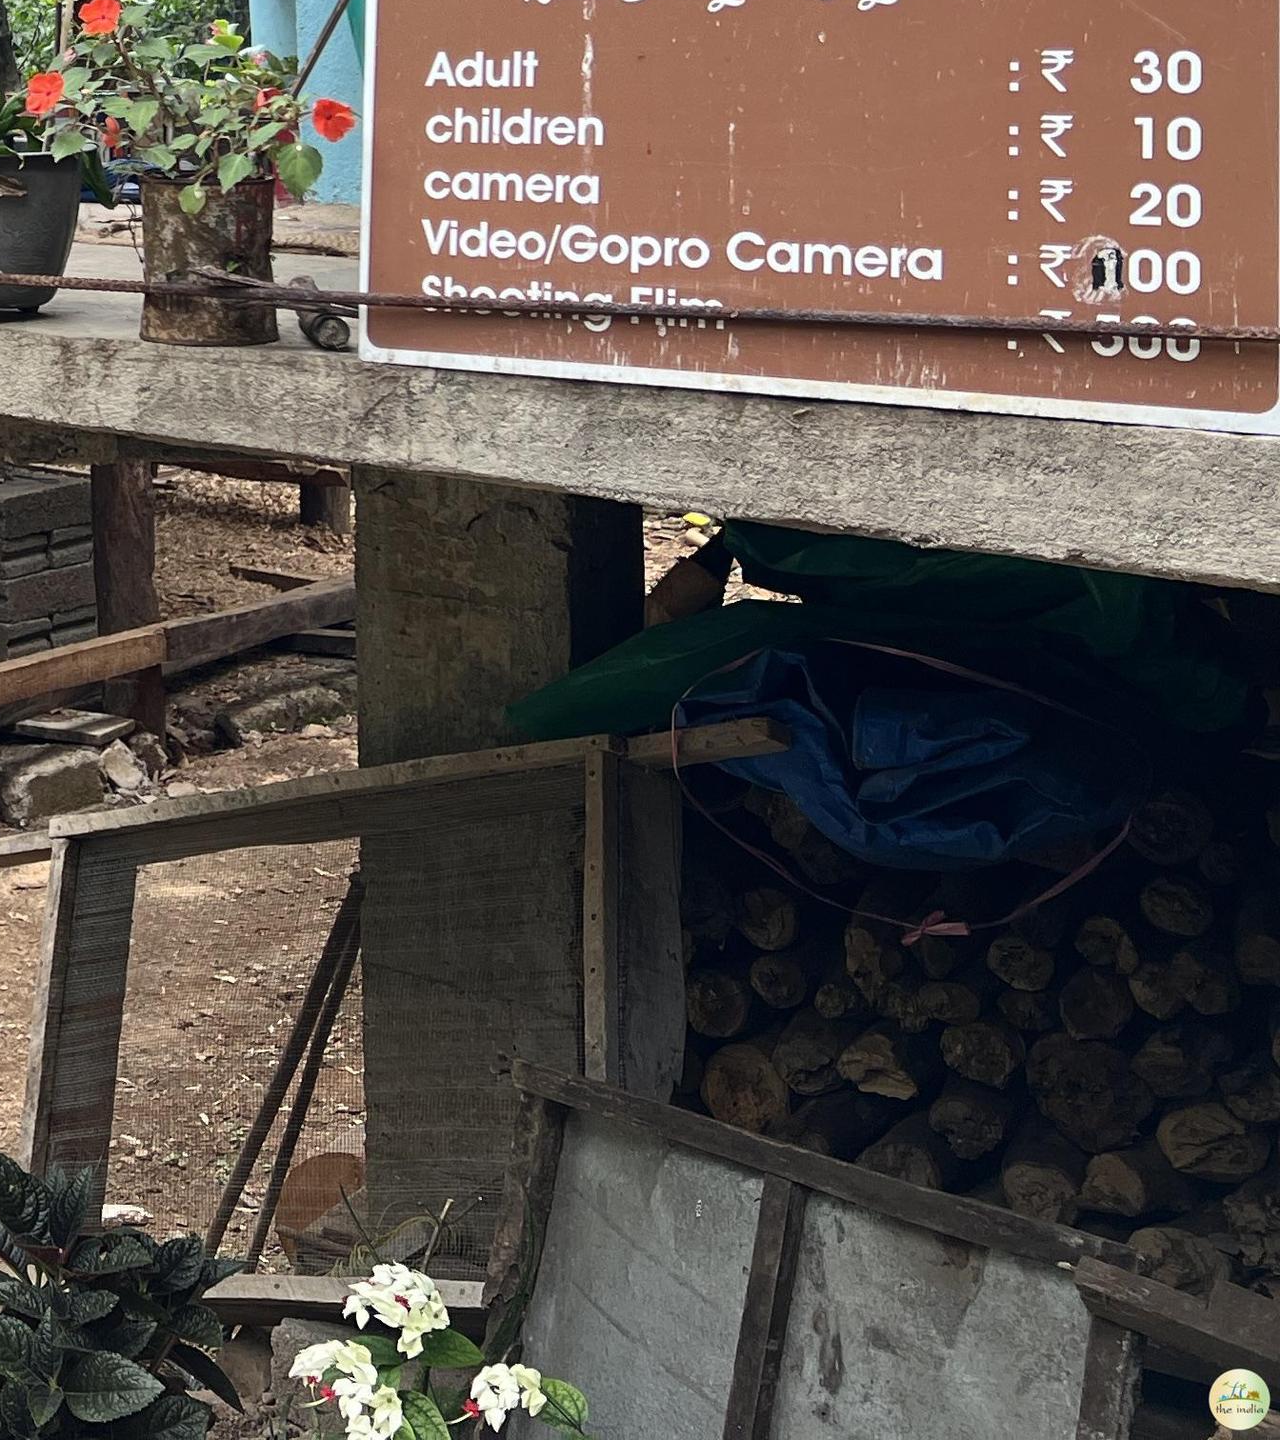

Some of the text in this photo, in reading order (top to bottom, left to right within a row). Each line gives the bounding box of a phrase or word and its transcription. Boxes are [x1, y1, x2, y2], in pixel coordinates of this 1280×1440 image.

[424, 50, 539, 88] Adult
[1129, 50, 1203, 94] 30
[425, 107, 604, 146] children
[1133, 116, 1203, 161] 10
[423, 170, 600, 205] camera
[1129, 183, 1202, 228] 20
[421, 218, 711, 274] Video/Gopro
[726, 231, 944, 281] Camera
